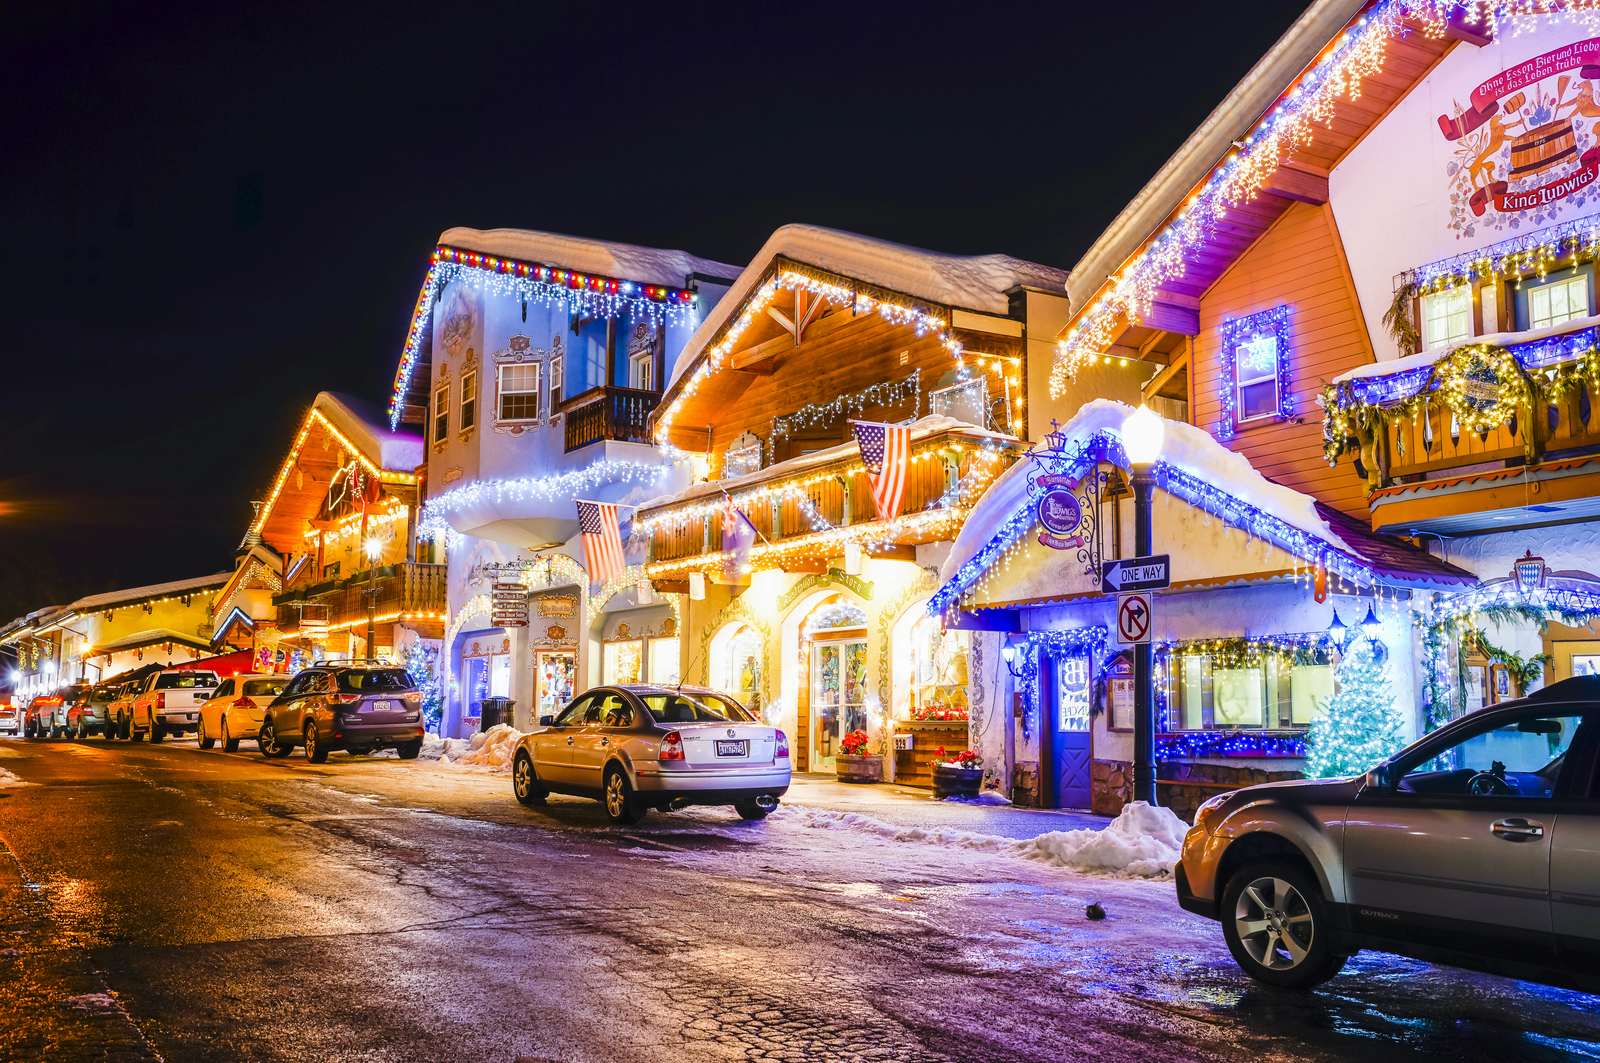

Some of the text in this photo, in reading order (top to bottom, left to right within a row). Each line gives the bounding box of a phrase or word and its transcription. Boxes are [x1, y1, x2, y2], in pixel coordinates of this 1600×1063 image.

[1479, 77, 1504, 96] Ohne
[1506, 63, 1534, 80] Essen
[1574, 41, 1600, 54] Liebe
[1495, 85, 1505, 97] ist
[1507, 77, 1523, 91] das
[1525, 66, 1553, 83] Leben
[1121, 565, 1162, 582] ONE WAY
